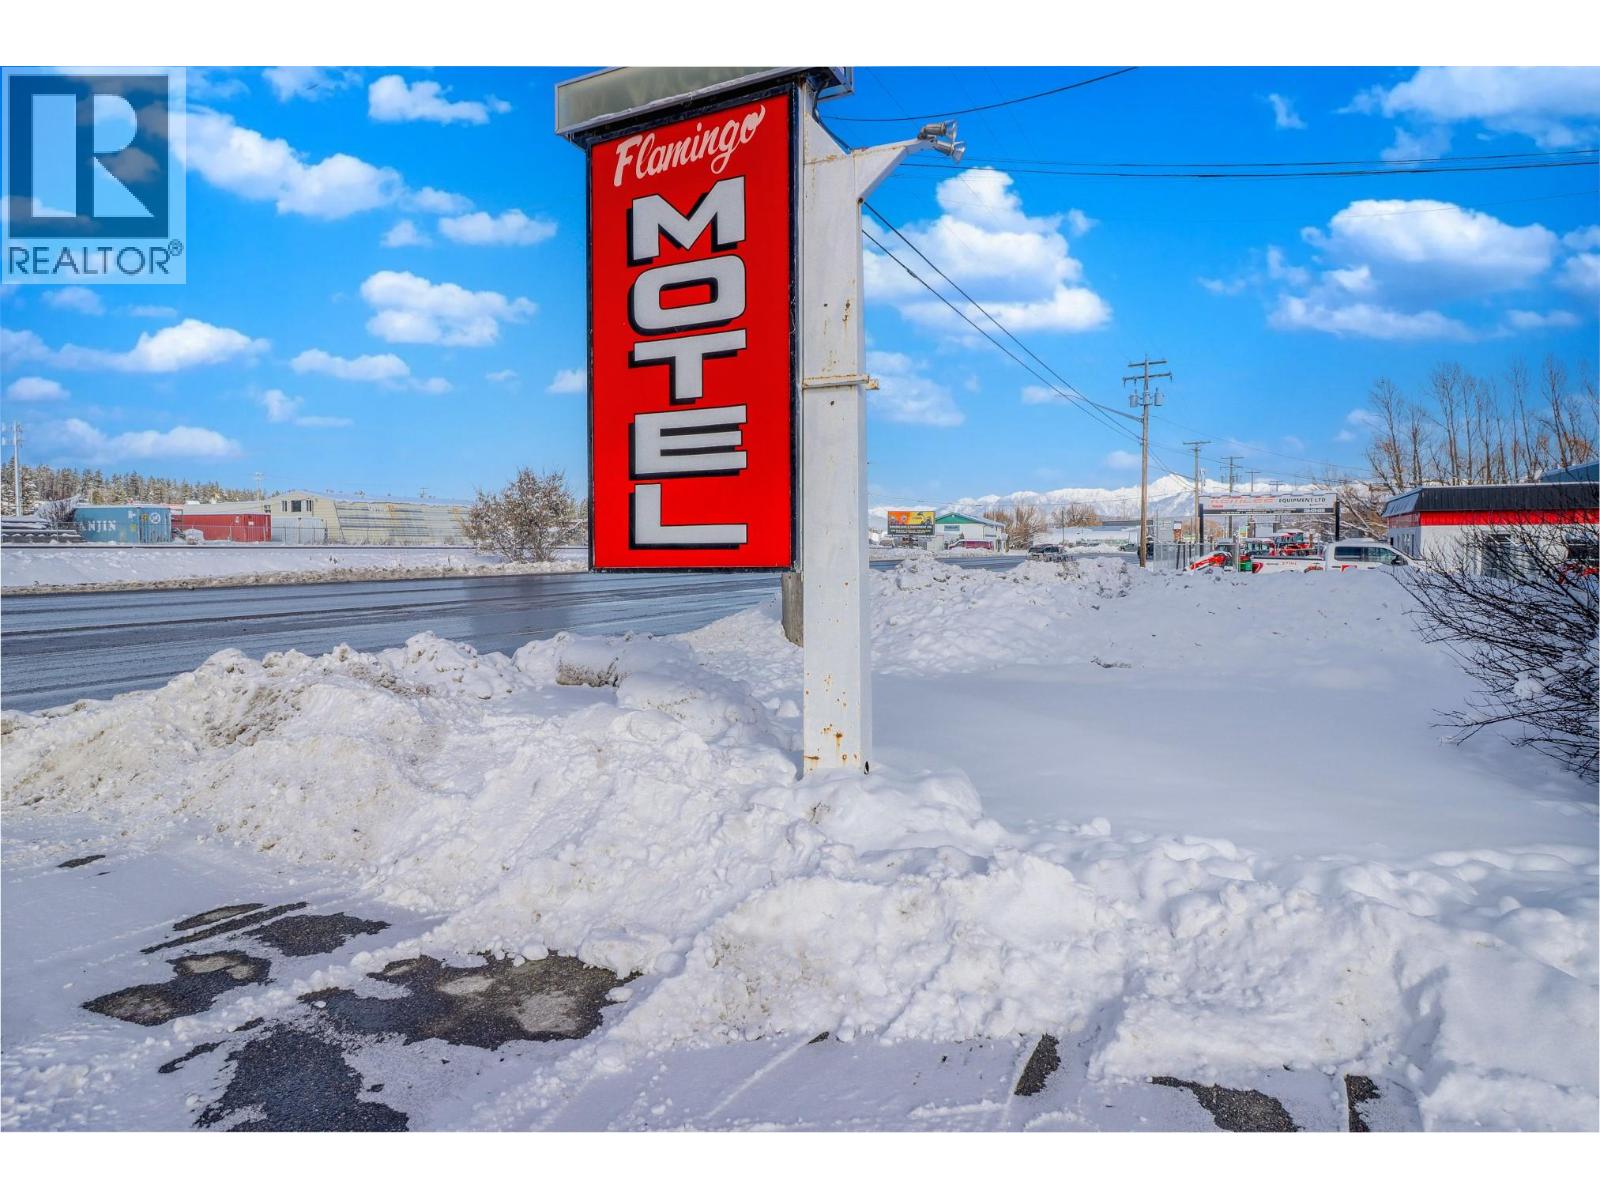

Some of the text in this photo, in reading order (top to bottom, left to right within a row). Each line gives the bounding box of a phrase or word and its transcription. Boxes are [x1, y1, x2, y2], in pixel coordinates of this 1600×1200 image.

[613, 104, 766, 187] Flamingo
[627, 175, 749, 550] MOTEL
[78, 520, 117, 532] ANJIN
